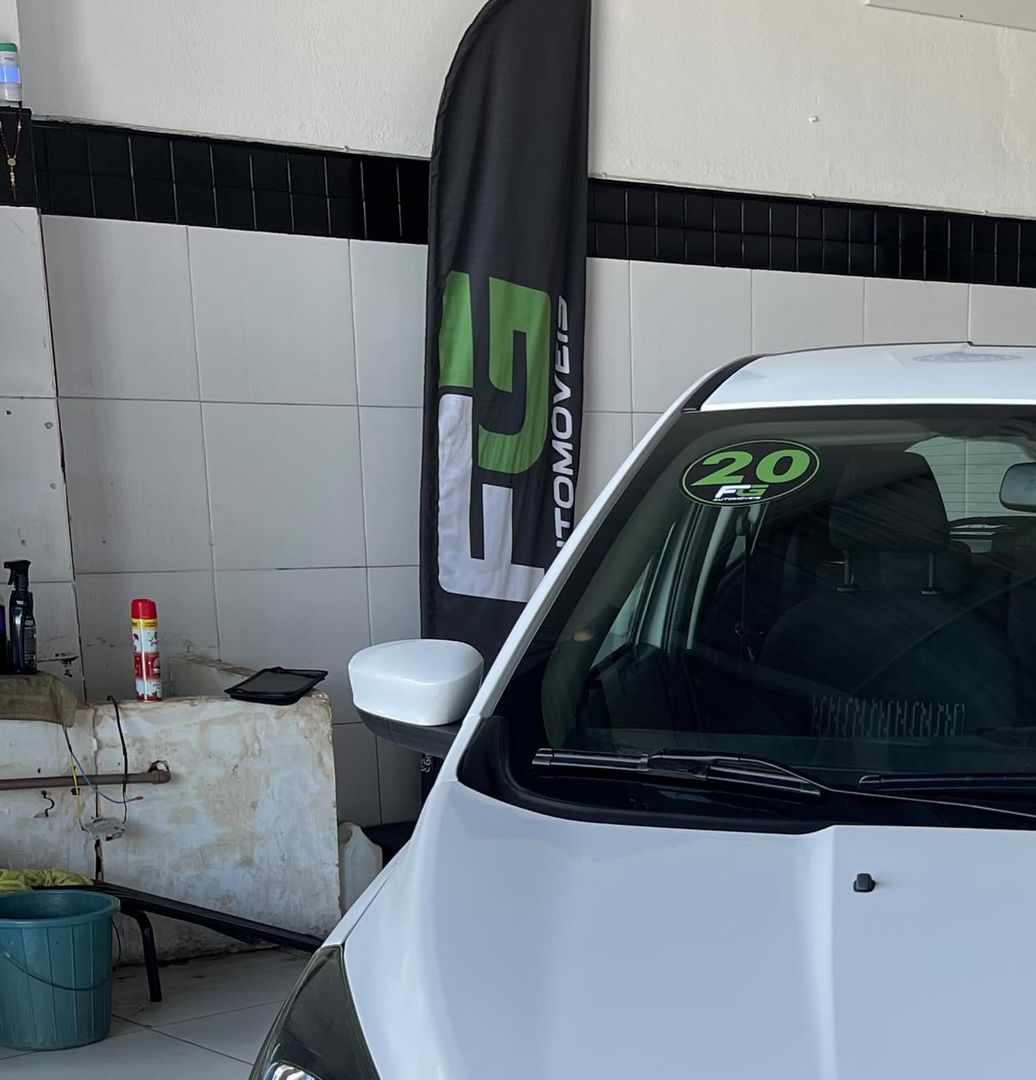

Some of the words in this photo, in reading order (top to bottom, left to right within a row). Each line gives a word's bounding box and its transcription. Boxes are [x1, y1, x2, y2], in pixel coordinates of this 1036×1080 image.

[438, 270, 550, 603] FG
[691, 449, 811, 486] 20
[714, 484, 770, 499] FG
